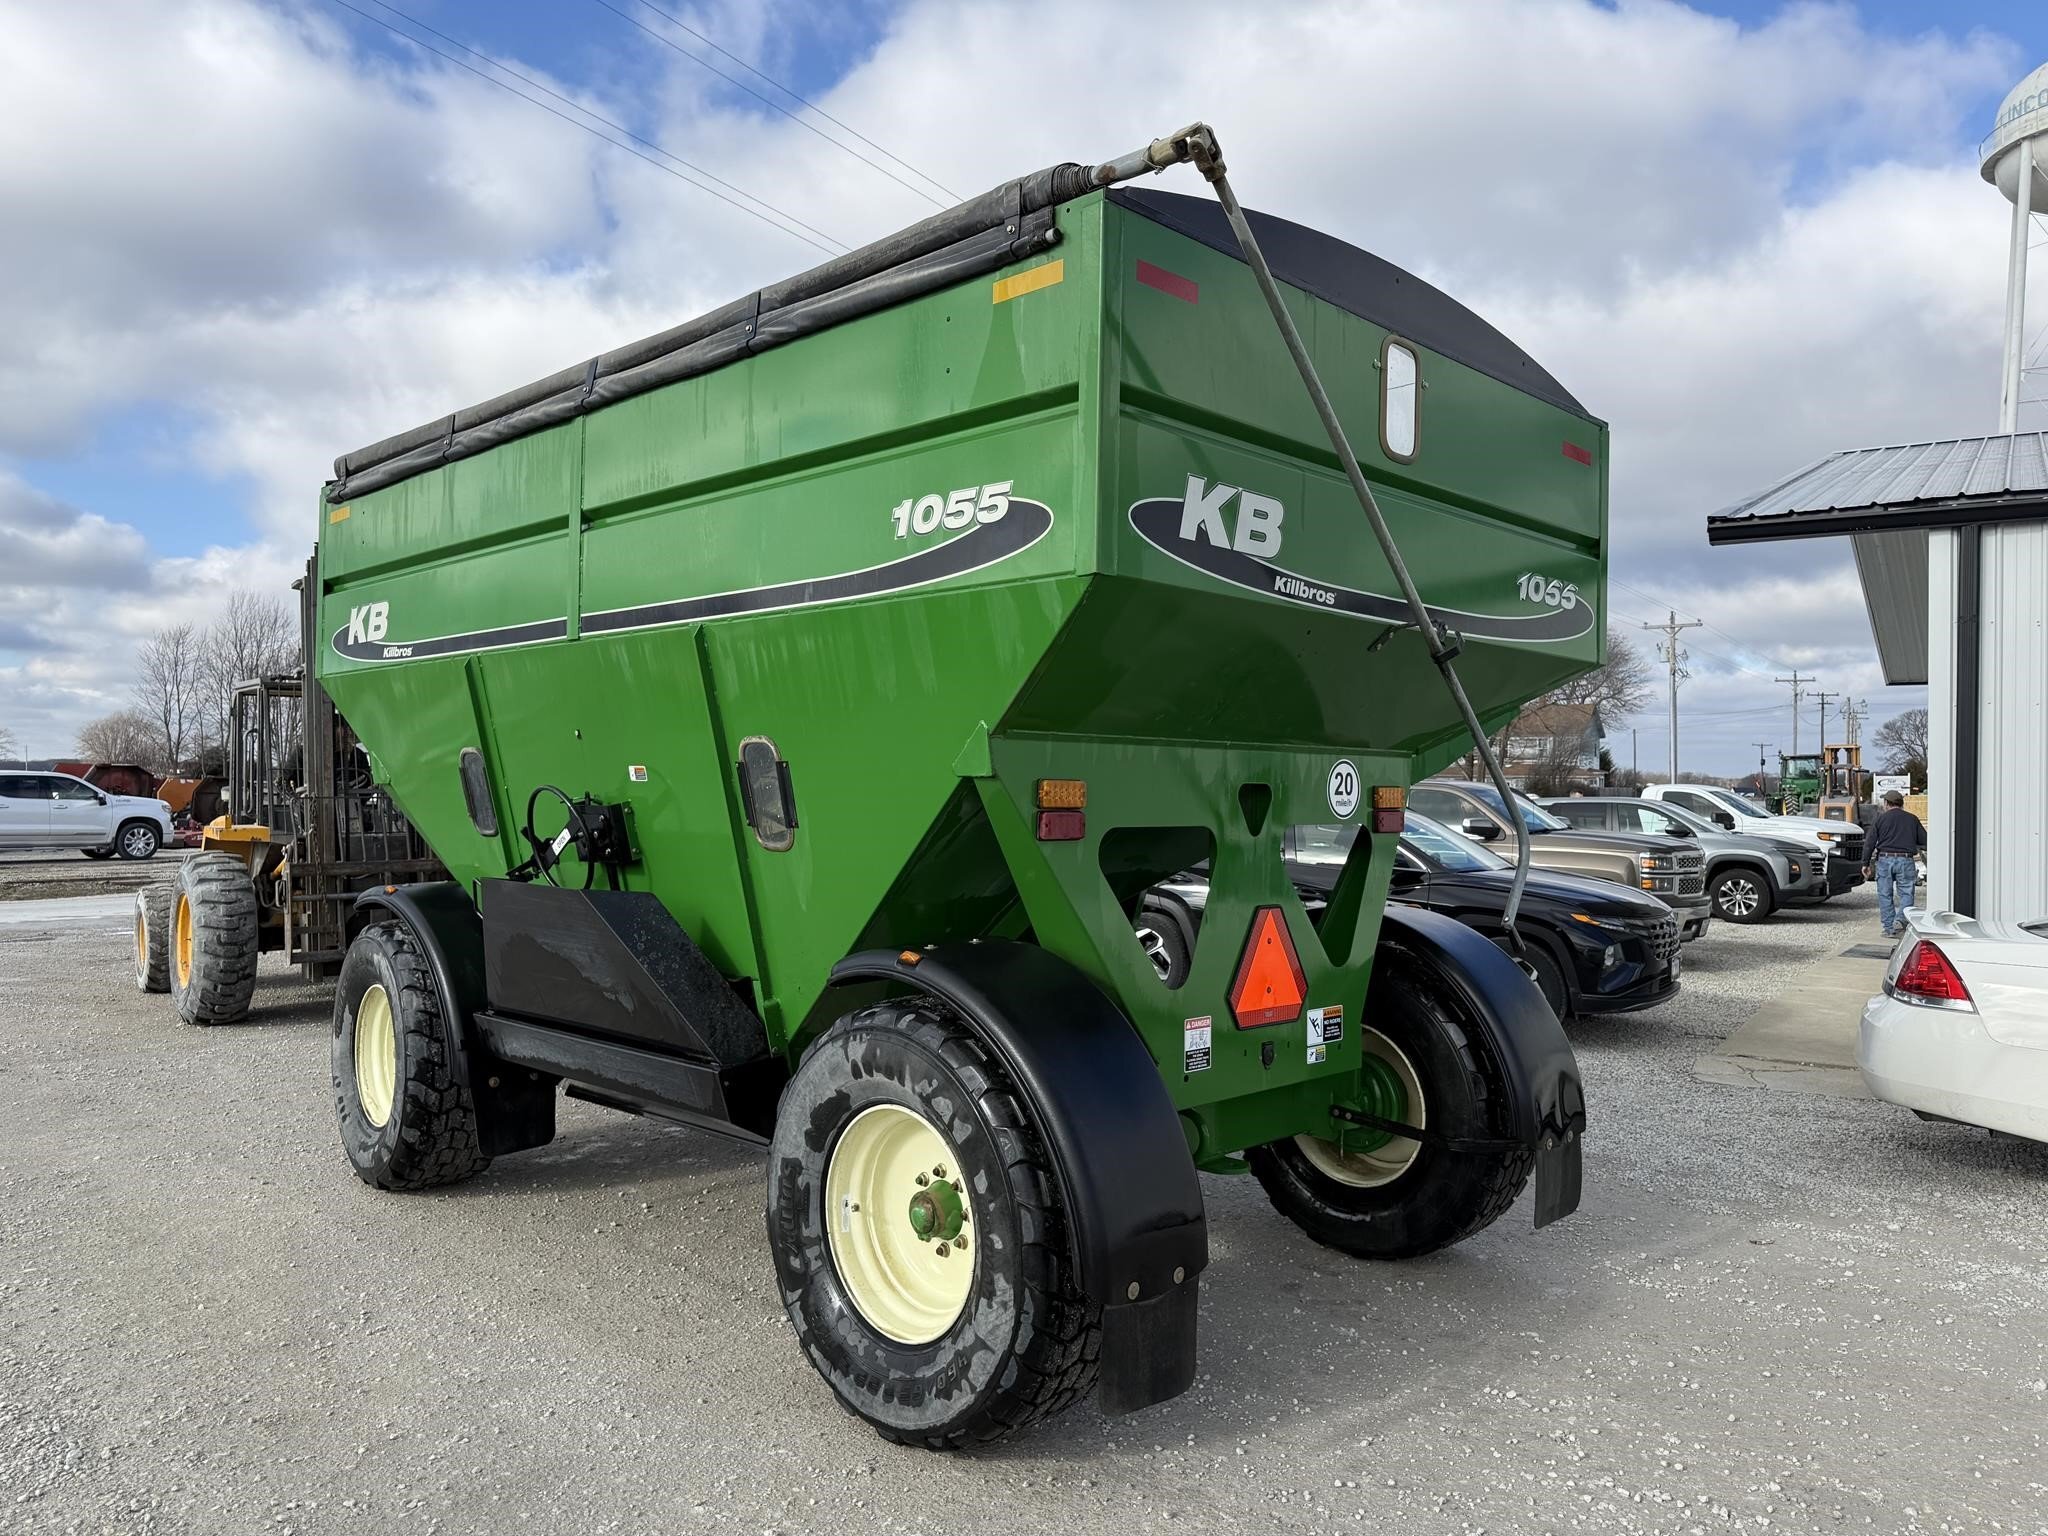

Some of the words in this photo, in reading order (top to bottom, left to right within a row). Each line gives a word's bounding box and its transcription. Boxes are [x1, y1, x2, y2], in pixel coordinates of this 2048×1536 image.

[891, 480, 1013, 540] 1055
[1178, 473, 1285, 559] KB
[1274, 575, 1336, 605] Killbros
[1517, 572, 1578, 610] 1055
[348, 602, 390, 645] KB
[383, 646, 413, 658] Killbros
[1334, 772, 1353, 795] 20
[1191, 1019, 1210, 1028] DANGER
